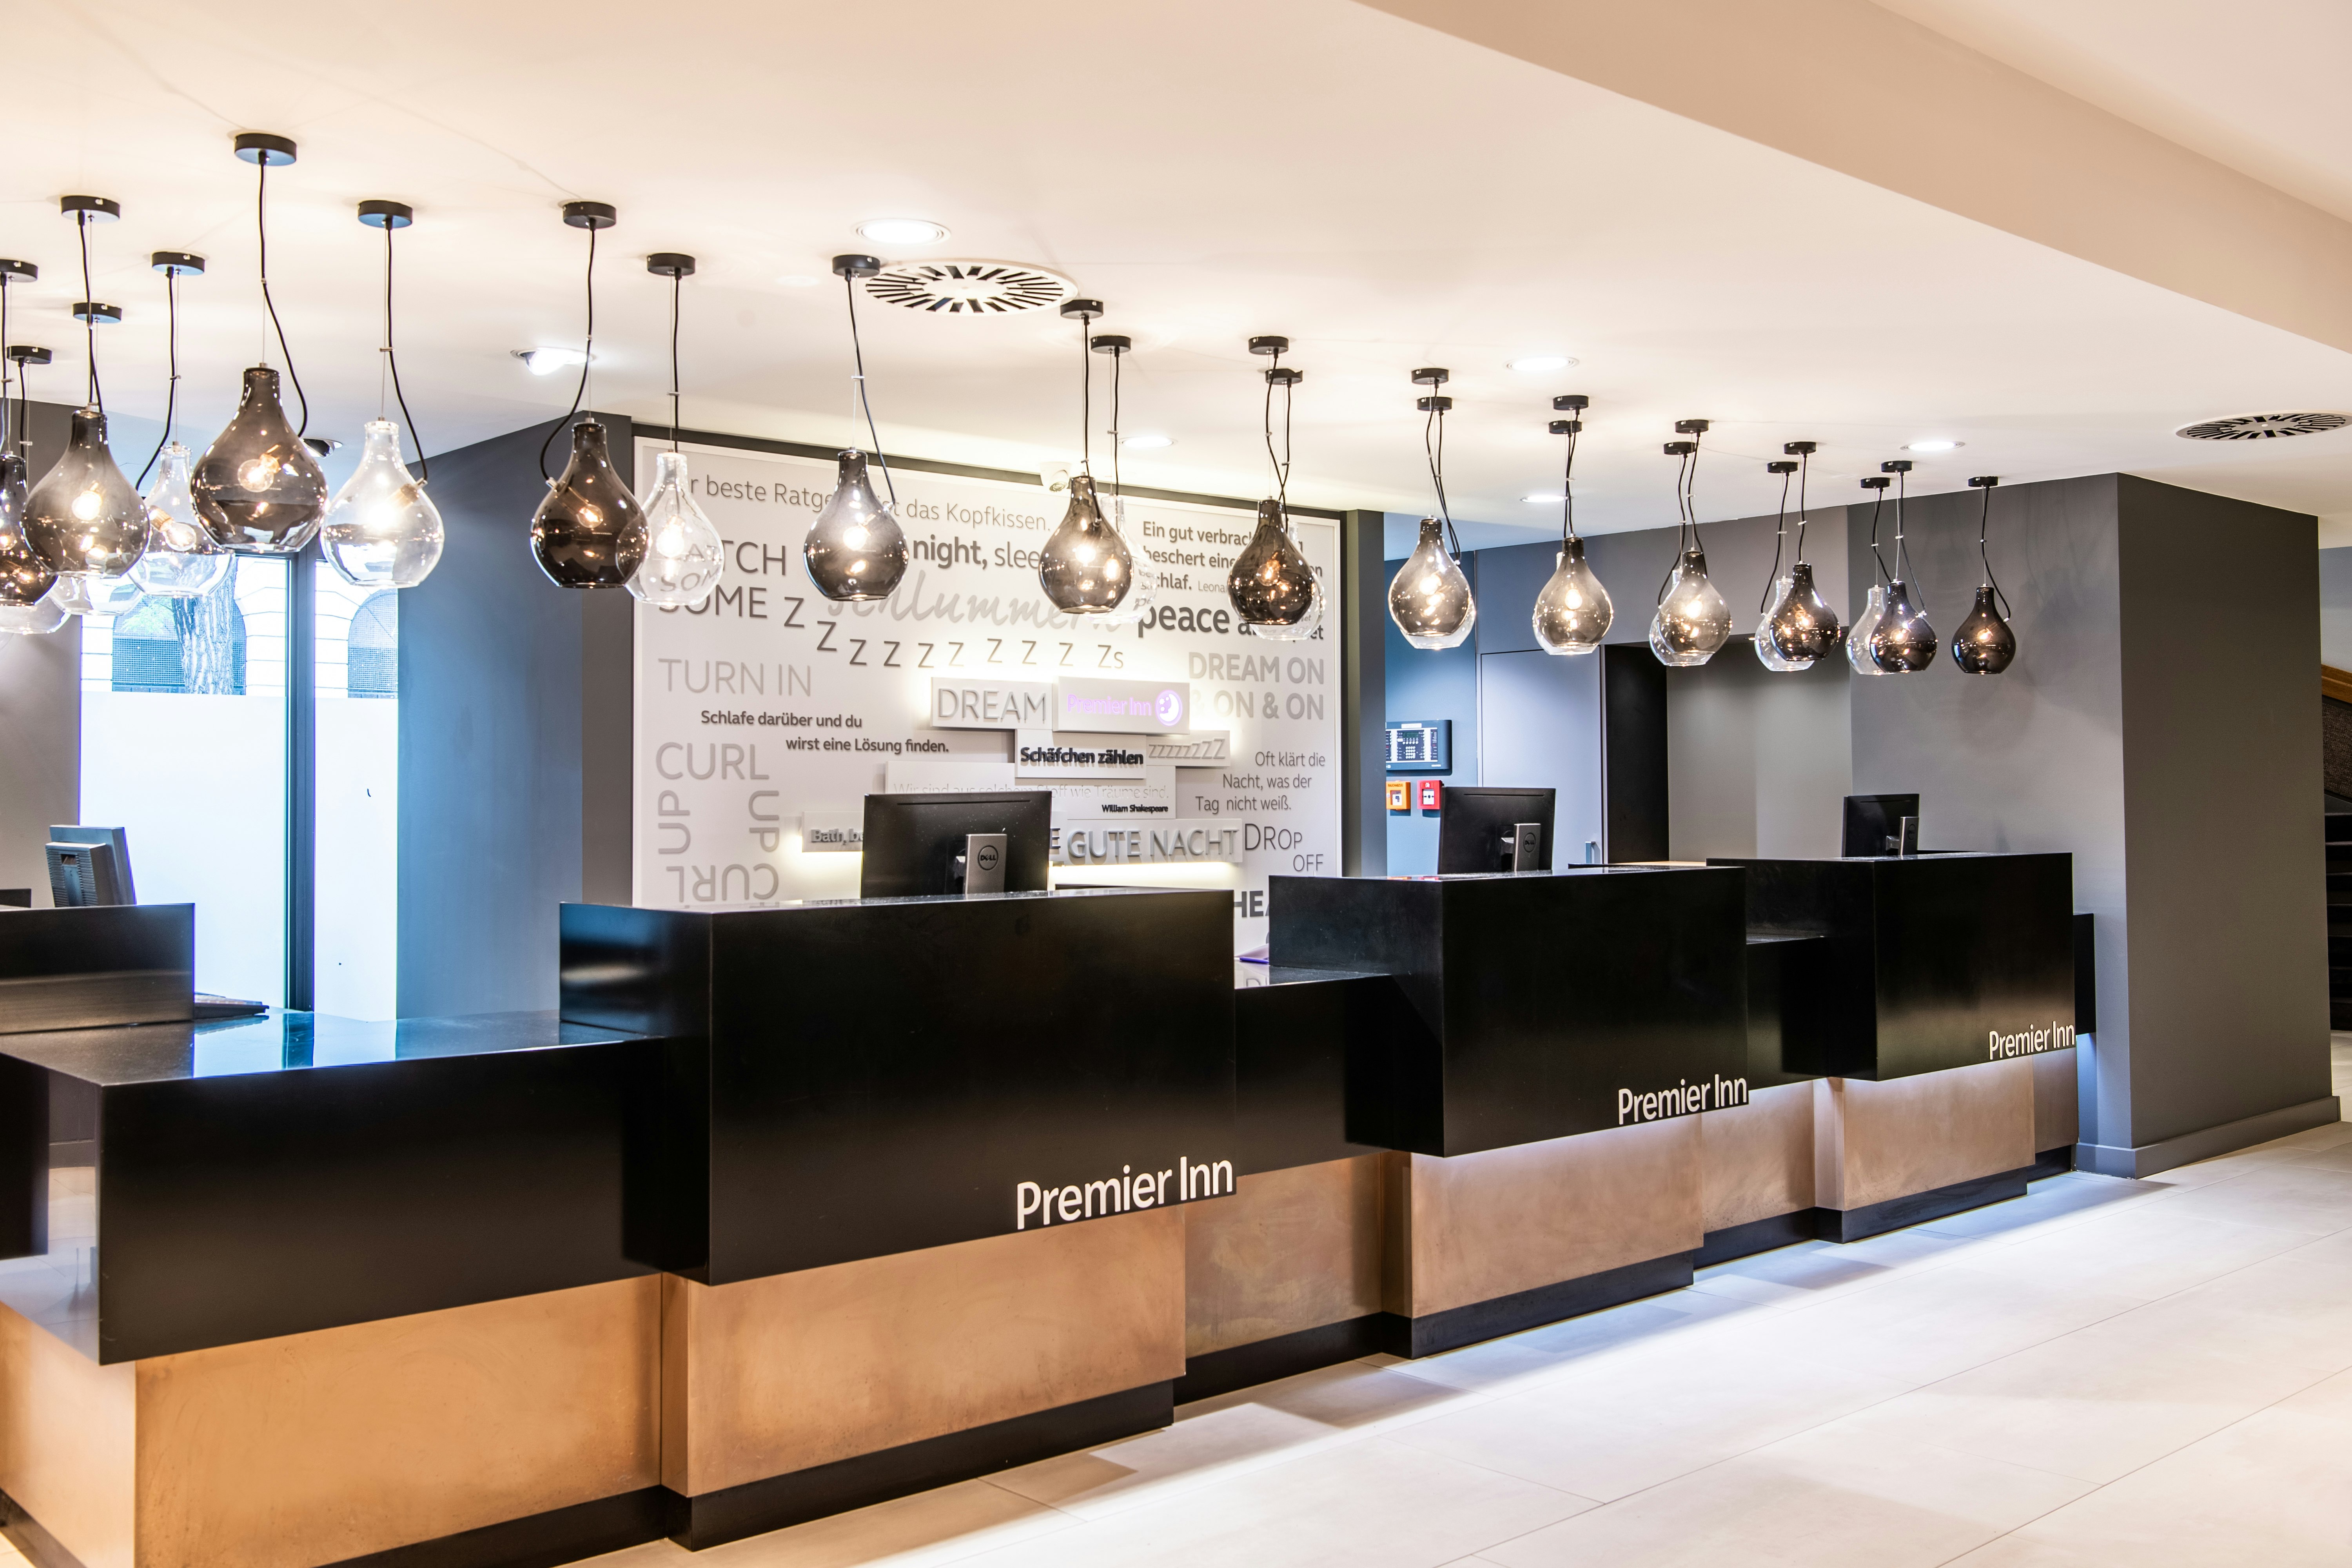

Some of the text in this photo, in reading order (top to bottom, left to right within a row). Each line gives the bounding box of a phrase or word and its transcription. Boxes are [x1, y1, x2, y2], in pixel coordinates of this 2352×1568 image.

[707, 474, 766, 501] beste
[775, 483, 833, 514] Ratge
[906, 499, 939, 520] das
[947, 502, 1051, 532] Kopfkissen.
[1143, 521, 1251, 546] Ein gut verbrac
[913, 534, 988, 570] night,
[995, 541, 1040, 569] slee
[1209, 552, 1236, 569] eine
[784, 597, 804, 628] Z
[1138, 605, 1230, 638] peace
[658, 658, 811, 697] TURN IN
[1189, 651, 1324, 685] DREAM ON
[701, 710, 862, 728] Schlafe darüber und du
[938, 688, 1047, 723] DREAM
[1067, 693, 1152, 717] Premier Inn
[1214, 690, 1254, 718] ON
[1262, 691, 1280, 719] &
[1286, 693, 1323, 720] ON
[786, 737, 949, 755] wirst eine Lösung finden.
[1020, 747, 1144, 765] Schäfchen zählen
[1255, 751, 1326, 767] Oft klärt die
[655, 742, 769, 780] CURL
[1071, 786, 1091, 798] wie
[1094, 785, 1140, 799] Träume
[1143, 785, 1169, 799] sind.
[1223, 773, 1312, 791] Nacht, was der
[1102, 804, 1169, 814] William Shakespeare
[1195, 795, 1292, 815] Tag nicht weiß.
[811, 829, 846, 846] Bath,
[1067, 830, 1142, 857] GUTE
[1150, 829, 1240, 856] NACHT
[1244, 823, 1303, 851] DROP
[1293, 854, 1324, 872] OFF
[666, 863, 780, 903] CURL
[1989, 1020, 2075, 1060] Premier Inn
[1618, 1074, 1747, 1125] Premier Inn
[1017, 1156, 1233, 1230] Premier Inn
